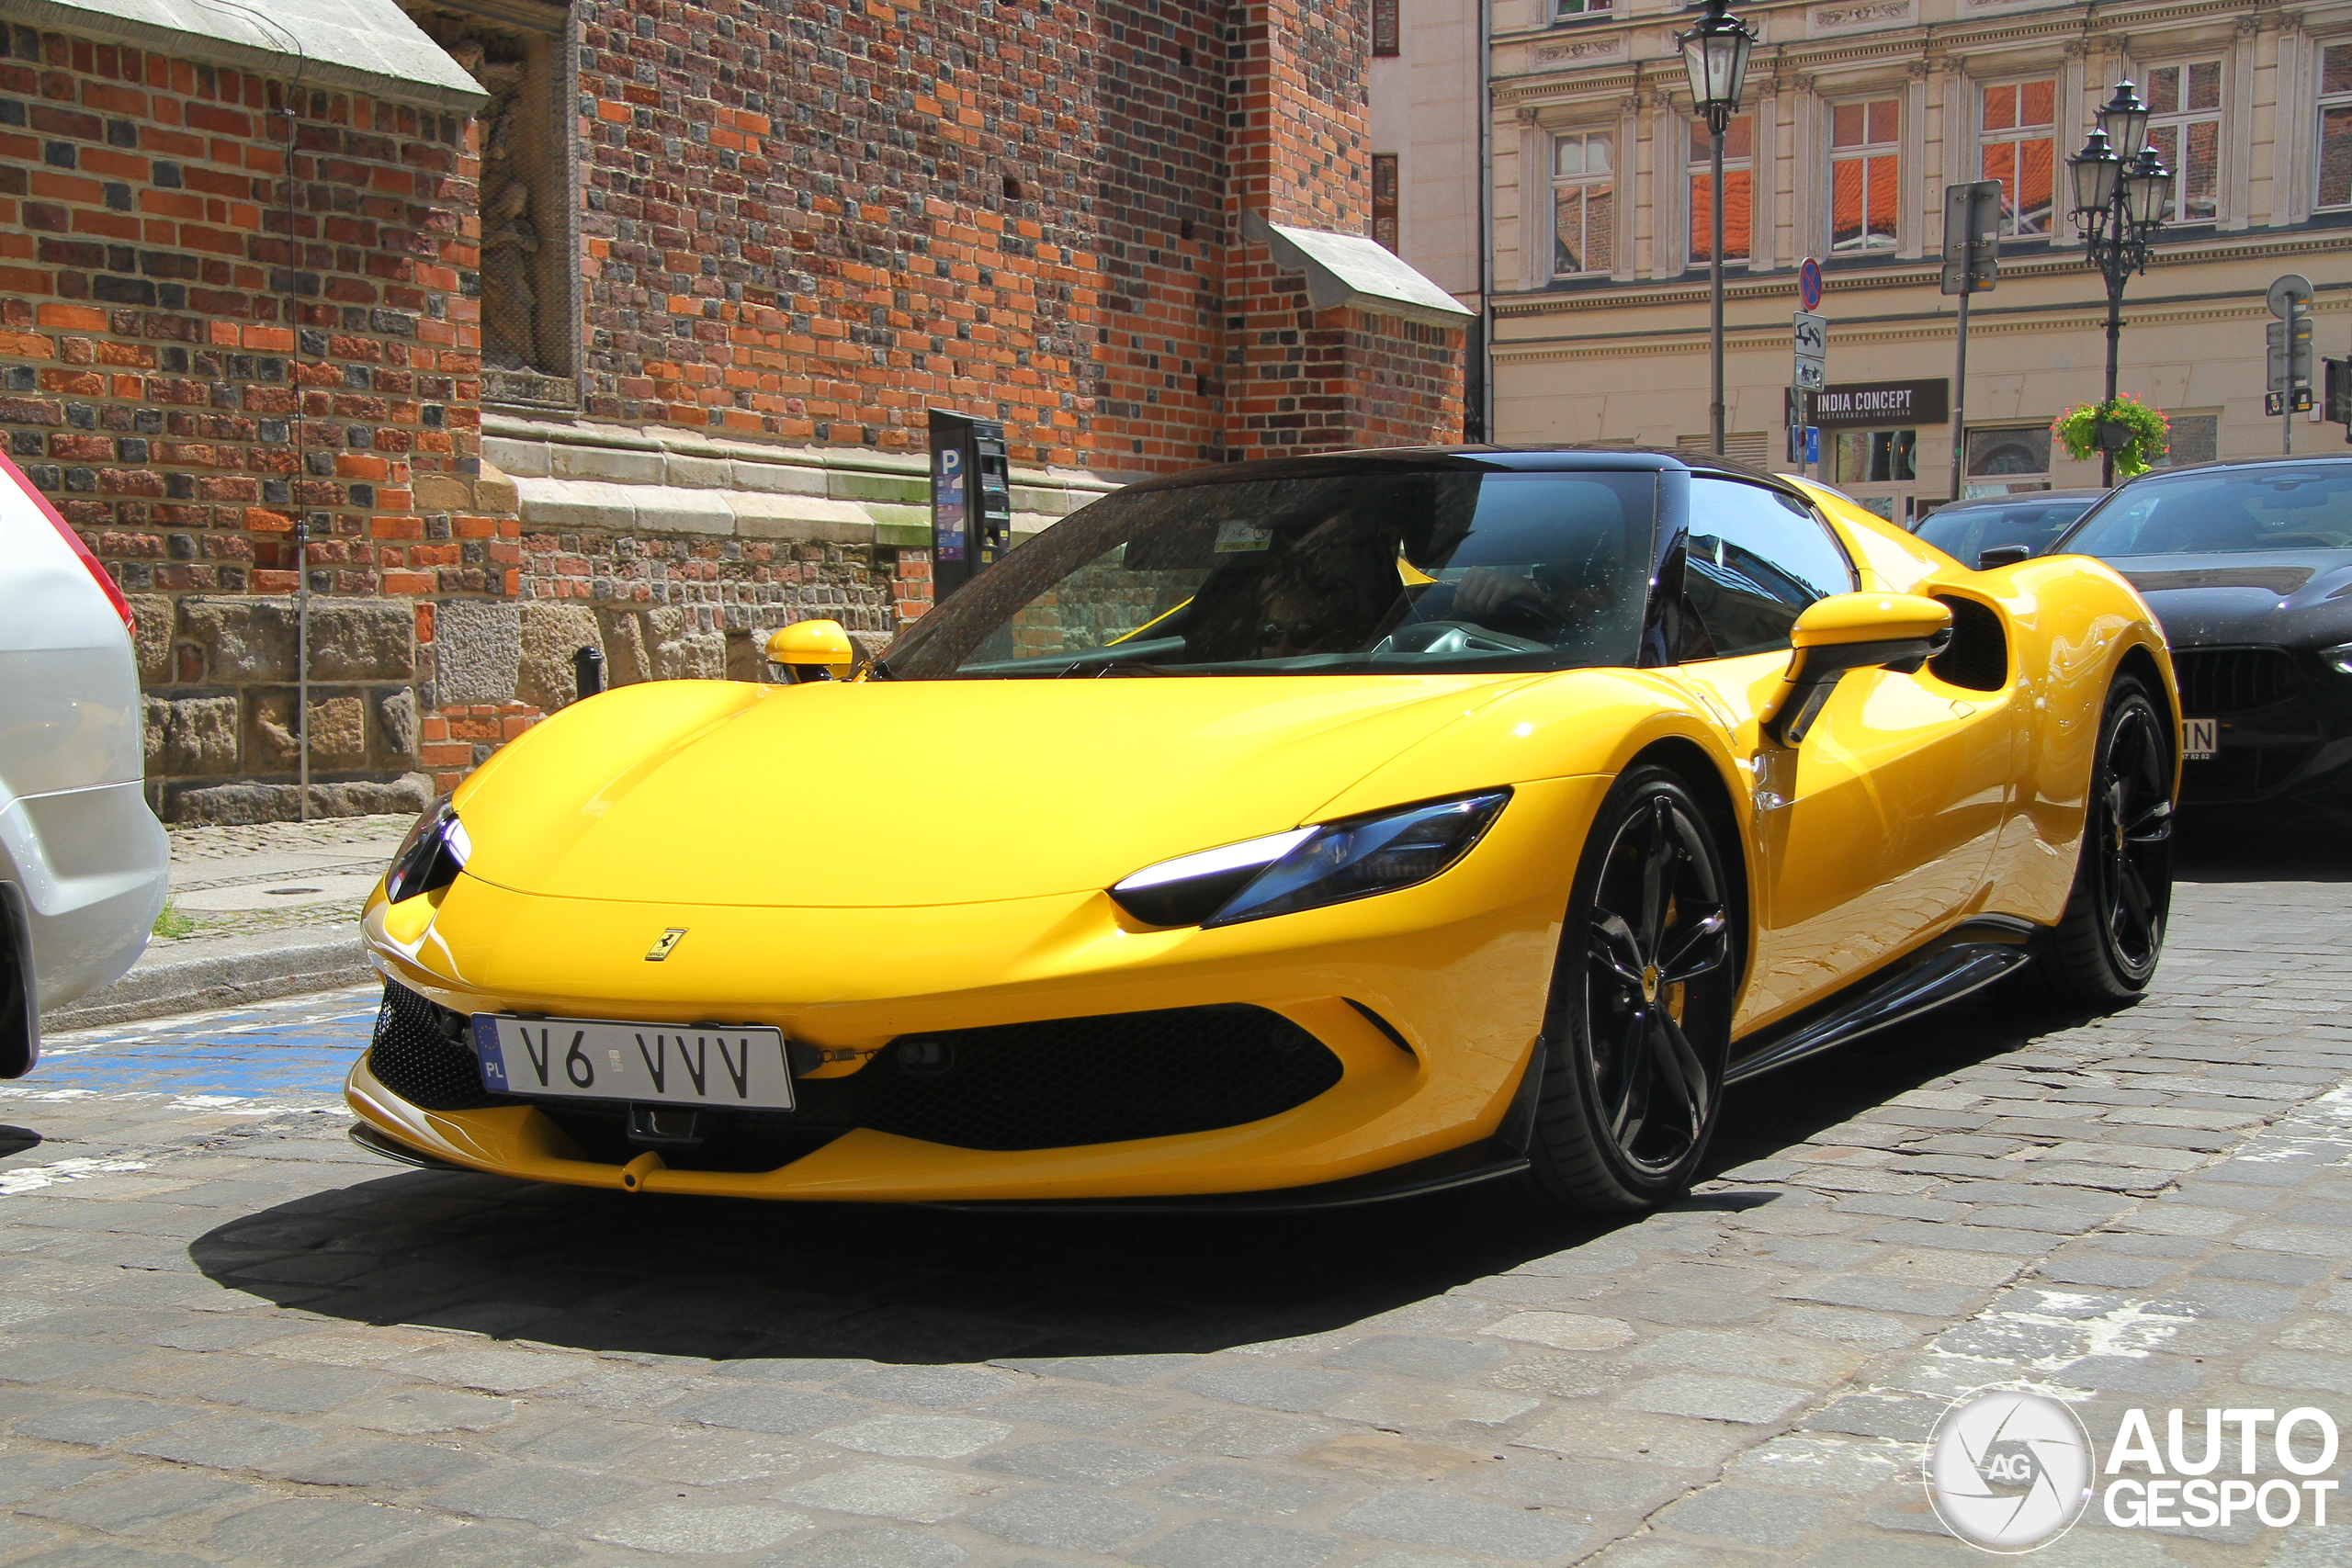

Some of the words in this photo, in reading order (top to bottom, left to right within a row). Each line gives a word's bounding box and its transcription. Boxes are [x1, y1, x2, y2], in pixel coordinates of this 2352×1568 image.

[1817, 393, 1851, 412] INDIA
[1855, 389, 1913, 411] CONCEPT
[1817, 412, 1869, 420] RESTAURACJA
[1872, 409, 1911, 417] INDYJSKA
[943, 449, 959, 474] P
[485, 1062, 504, 1079] PL
[520, 1027, 595, 1089] V6
[635, 1033, 748, 1099] VVV
